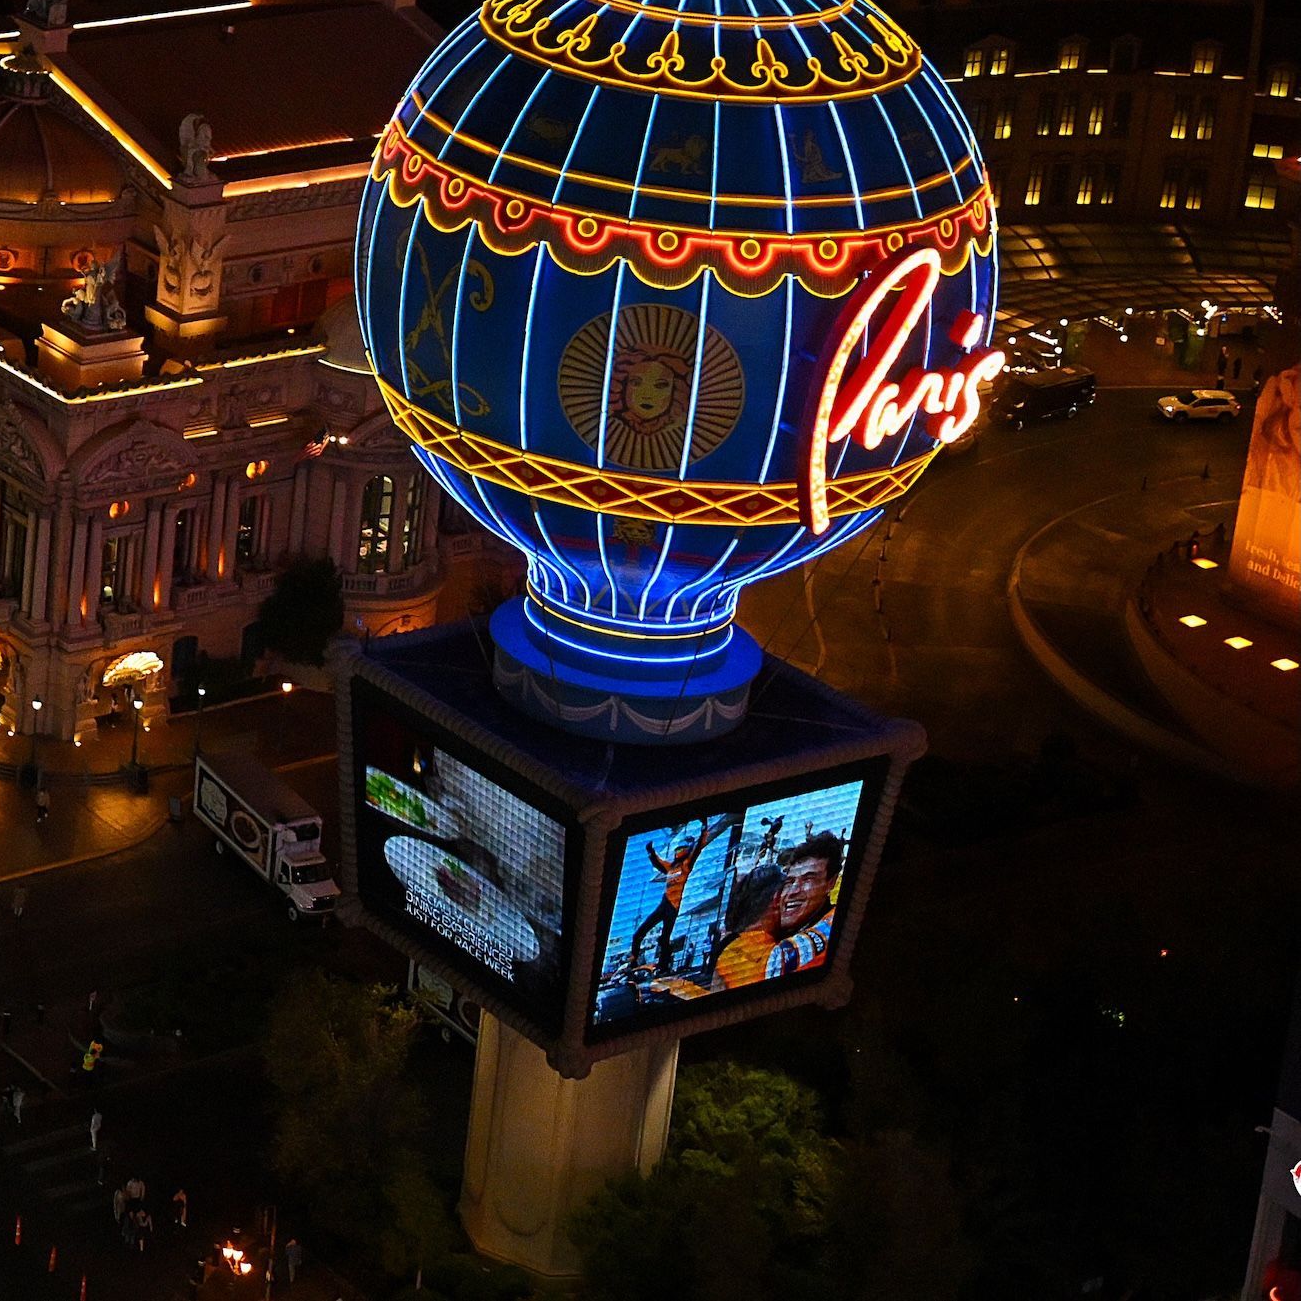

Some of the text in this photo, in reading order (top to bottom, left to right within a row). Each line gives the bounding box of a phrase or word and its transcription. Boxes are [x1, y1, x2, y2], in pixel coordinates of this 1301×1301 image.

[809, 247, 1006, 536] Paris
[1247, 559, 1270, 577] and
[404, 903, 515, 983] JUST FOR RACE WEEK
[405, 890, 513, 970] DINING EXPERIENCES
[407, 879, 514, 959] SPECIALLY CURATED
